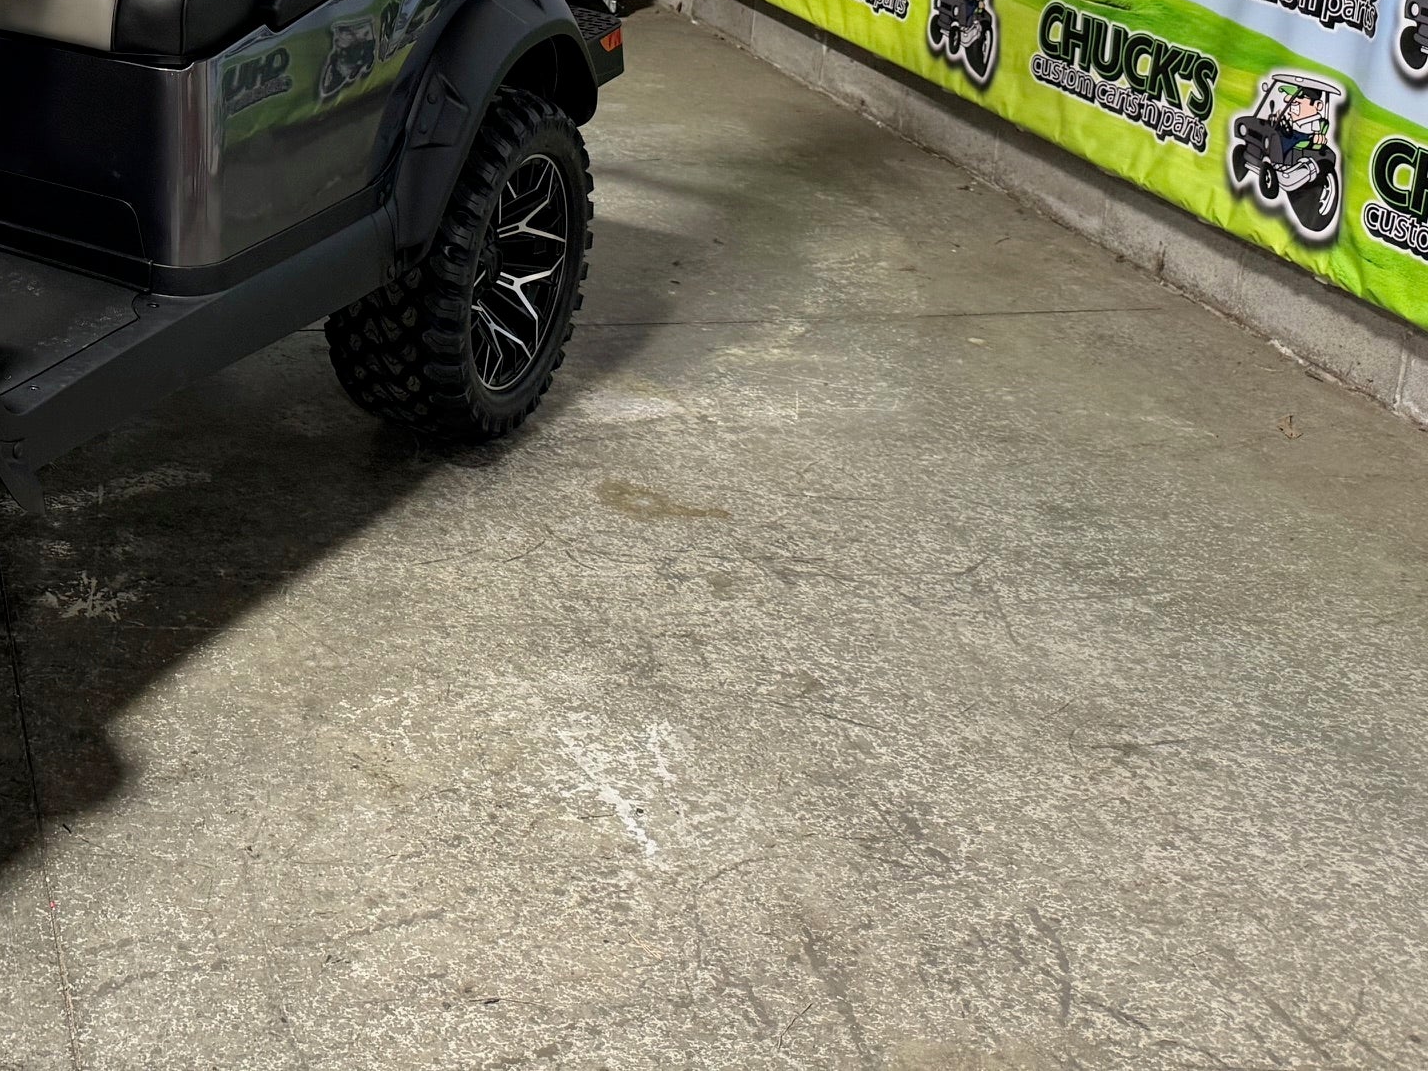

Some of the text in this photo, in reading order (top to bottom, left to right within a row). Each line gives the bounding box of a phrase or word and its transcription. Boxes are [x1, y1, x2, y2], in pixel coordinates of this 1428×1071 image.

[1032, 54, 1094, 97] custom
[1158, 106, 1204, 146] parts
[1039, 2, 1218, 120] CHUCK'S
